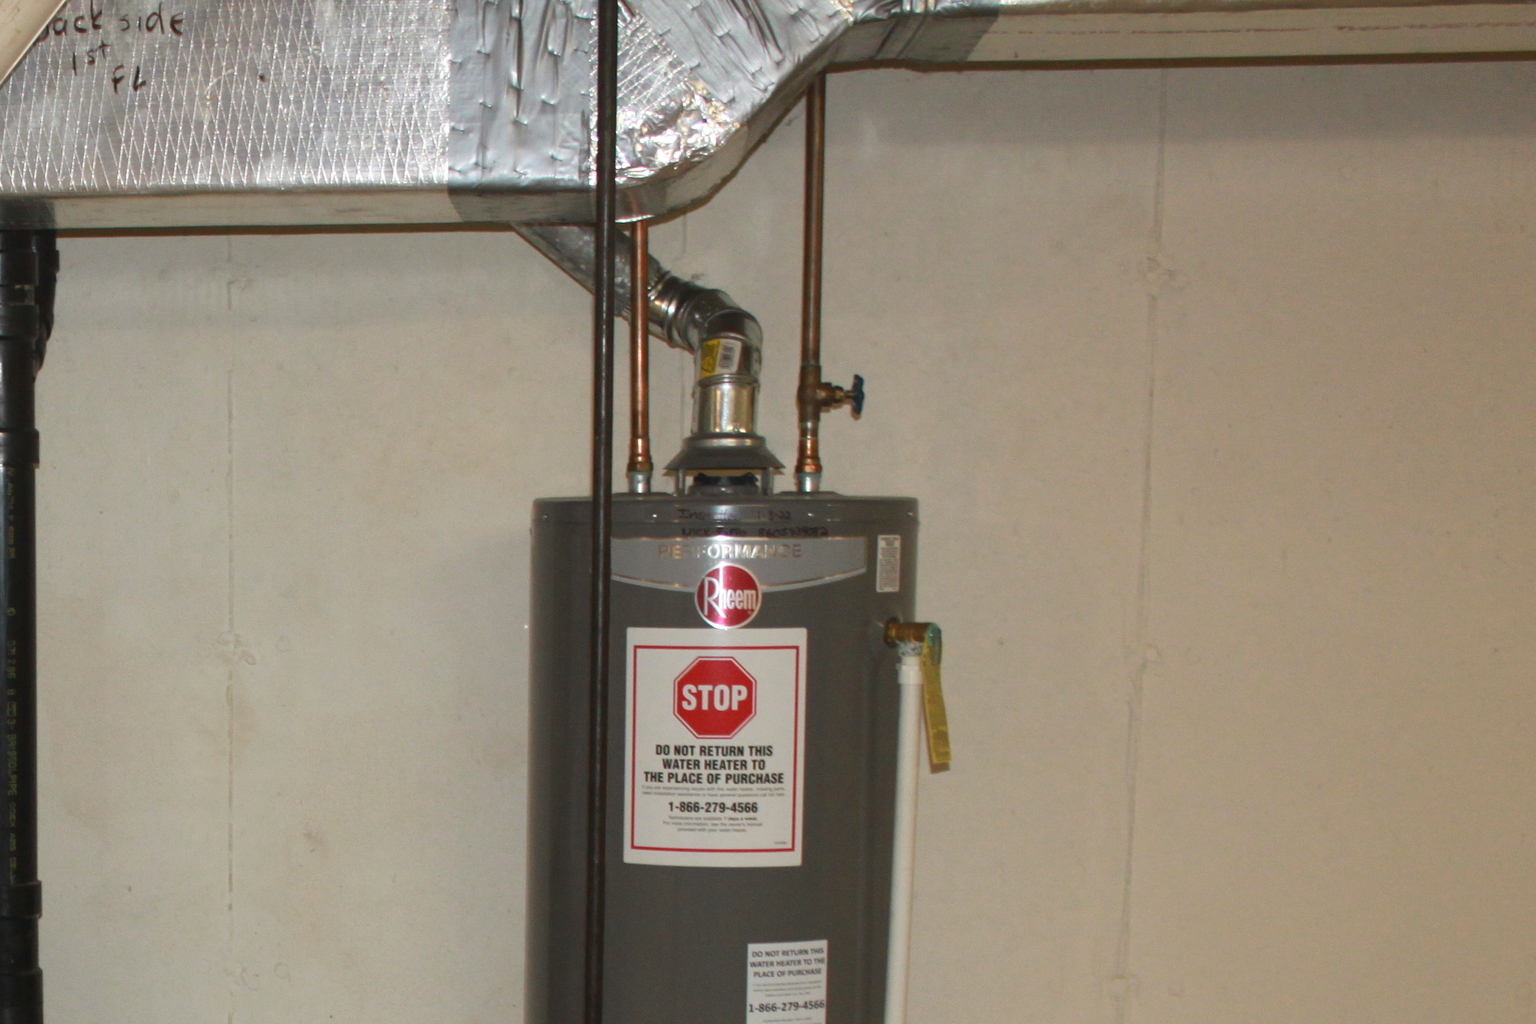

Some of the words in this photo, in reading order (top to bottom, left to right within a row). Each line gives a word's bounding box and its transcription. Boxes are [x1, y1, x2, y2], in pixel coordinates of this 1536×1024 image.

[72, 41, 111, 76] 1st
[704, 562, 757, 618] Rheem
[681, 684, 748, 711] STOP
[656, 744, 670, 756] DO
[674, 745, 696, 756] NOT
[699, 745, 744, 756] RETURN
[748, 745, 773, 757] THIS
[662, 758, 700, 770] WATER
[704, 759, 747, 770] HEATER
[752, 759, 765, 770] TO
[644, 771, 664, 783] THE
[667, 772, 703, 784] PLACE
[707, 772, 722, 784] OF
[725, 772, 784, 784] PURCHASE
[668, 801, 758, 813] 1-866-279-4566
[810, 947, 824, 955] THIS
[775, 959, 802, 967] HEATER
[803, 958, 812, 966] TO
[753, 970, 775, 978] PLACE
[787, 968, 822, 976] PURCHASE
[748, 1000, 825, 1013] 1-866-279-4566
